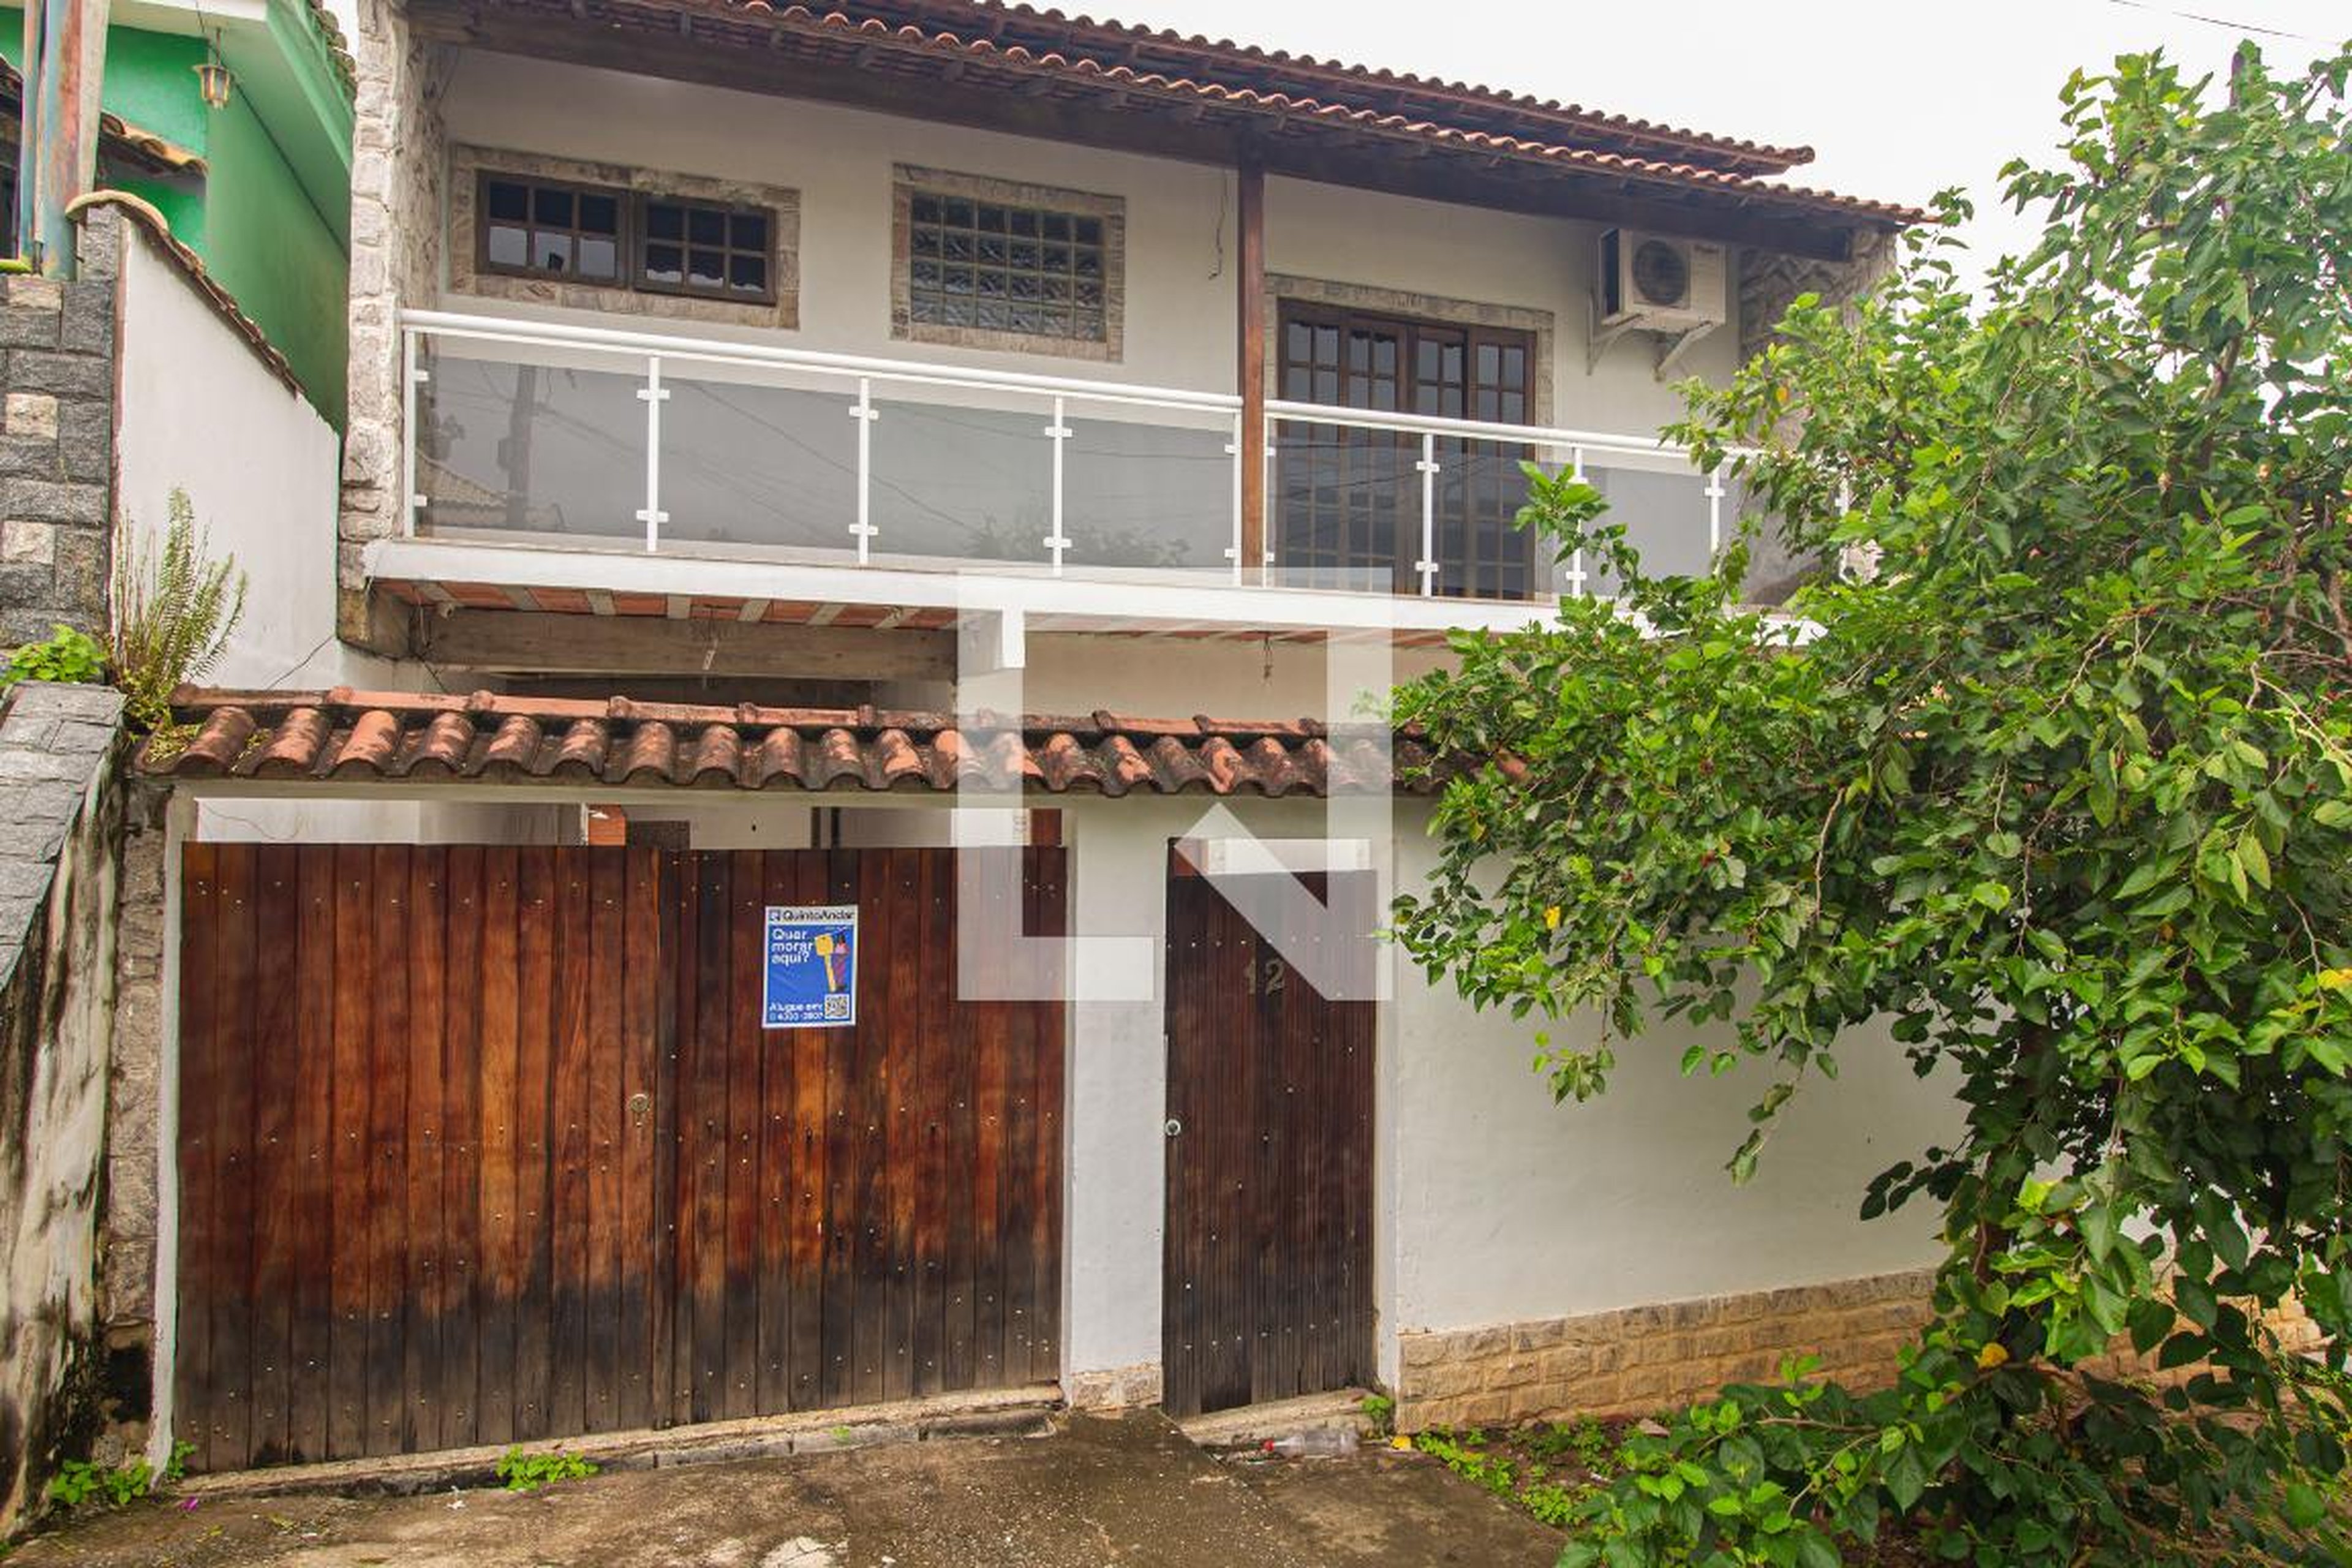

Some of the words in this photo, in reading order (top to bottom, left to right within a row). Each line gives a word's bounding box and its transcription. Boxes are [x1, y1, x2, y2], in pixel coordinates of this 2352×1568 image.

[783, 910, 854, 921] QuintoAndar
[772, 928, 807, 940] Quer
[771, 941, 813, 952] morar
[771, 950, 809, 967] aqui?
